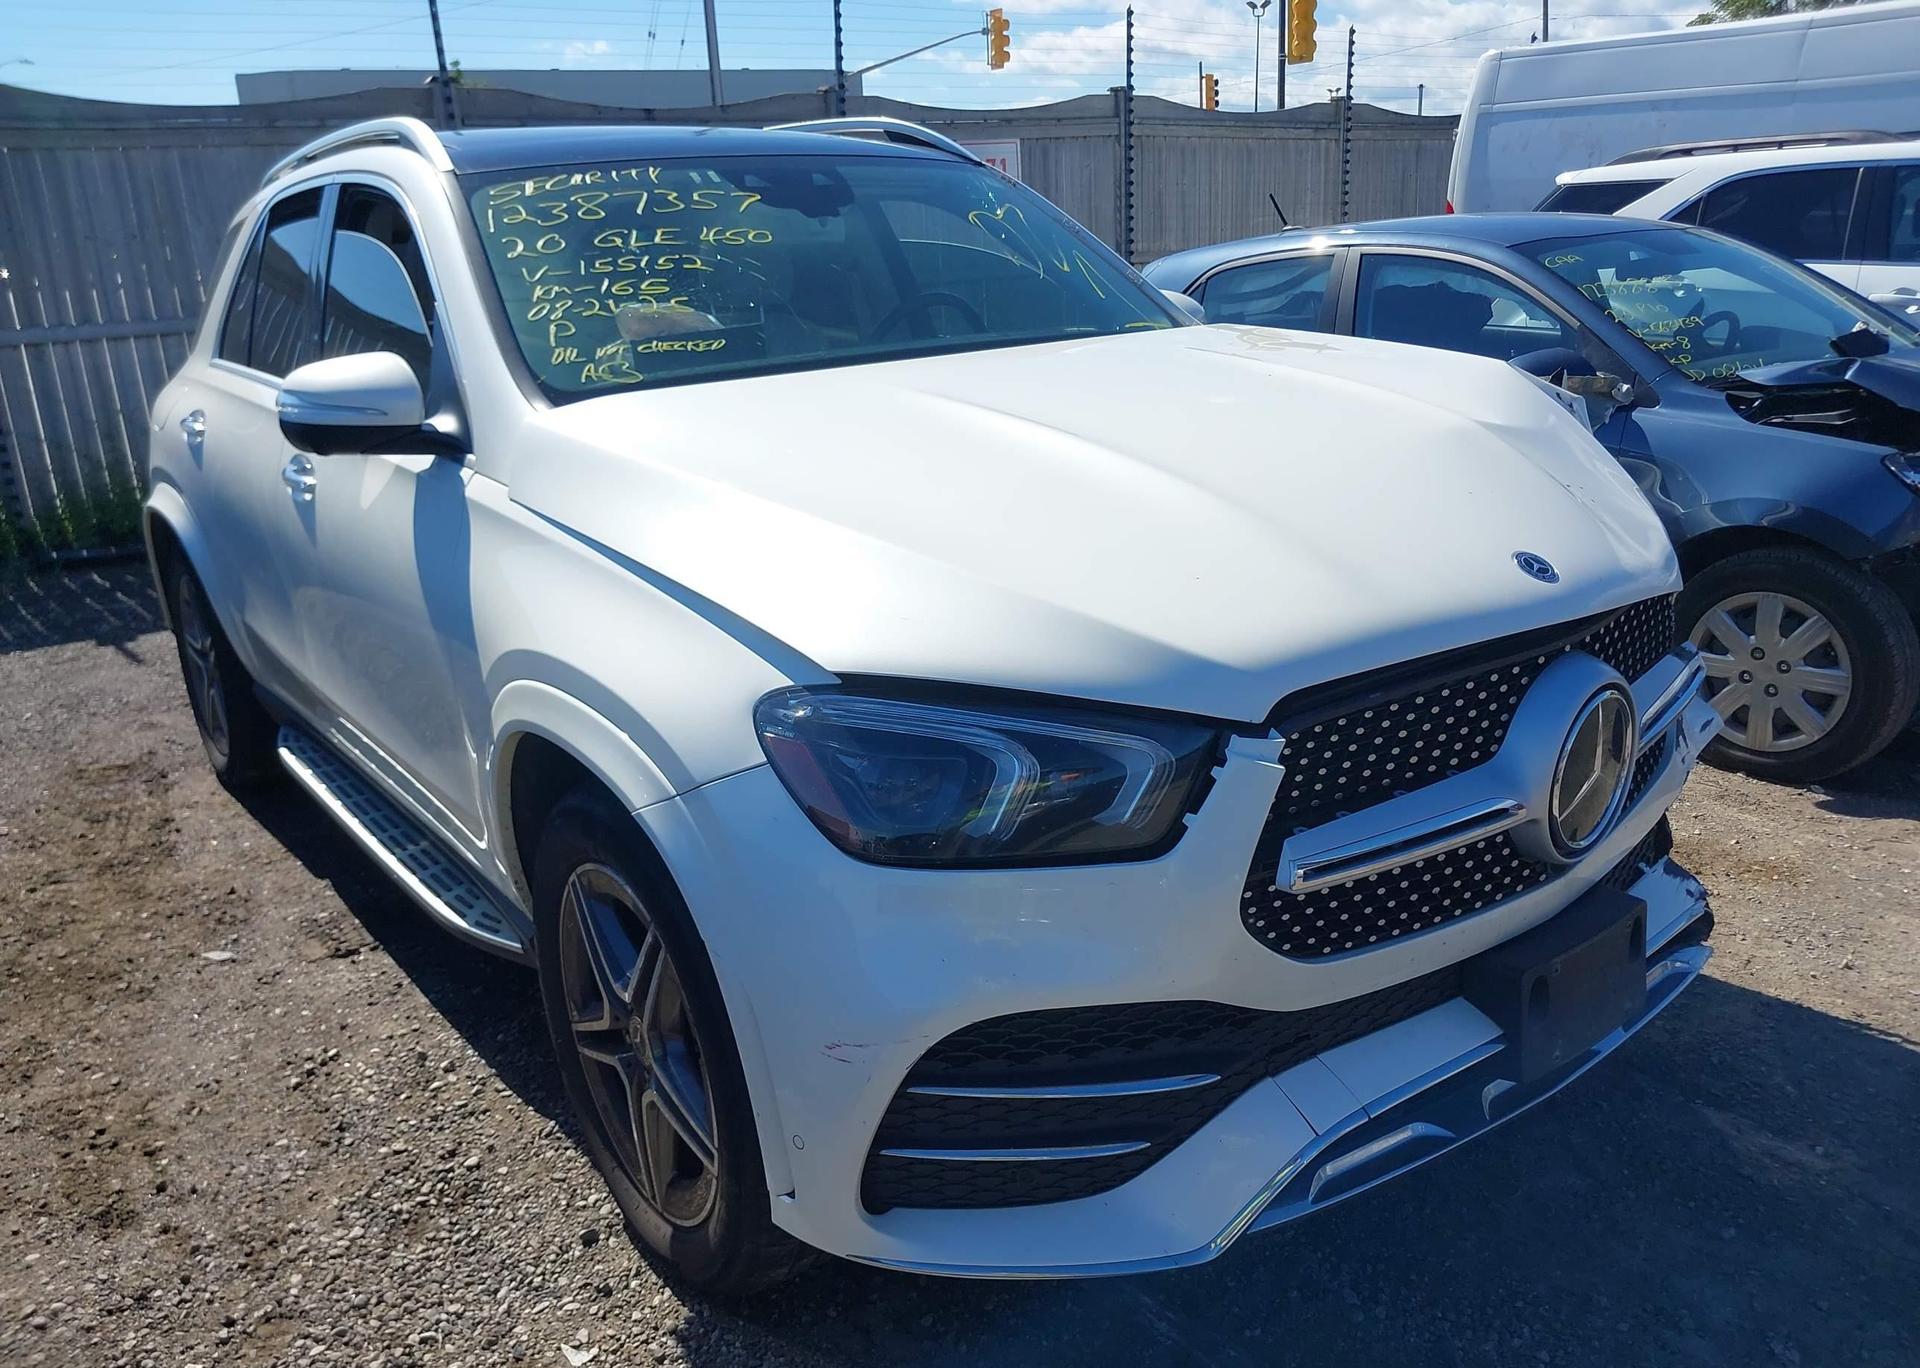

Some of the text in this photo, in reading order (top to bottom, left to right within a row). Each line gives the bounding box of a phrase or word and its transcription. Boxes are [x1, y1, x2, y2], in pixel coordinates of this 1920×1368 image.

[488, 190, 761, 232] 12387357
[502, 226, 773, 258] 20 GLE 450
[1544, 254, 1584, 268] CAA
[549, 321, 576, 347] P
[637, 338, 726, 353] CHECKED
